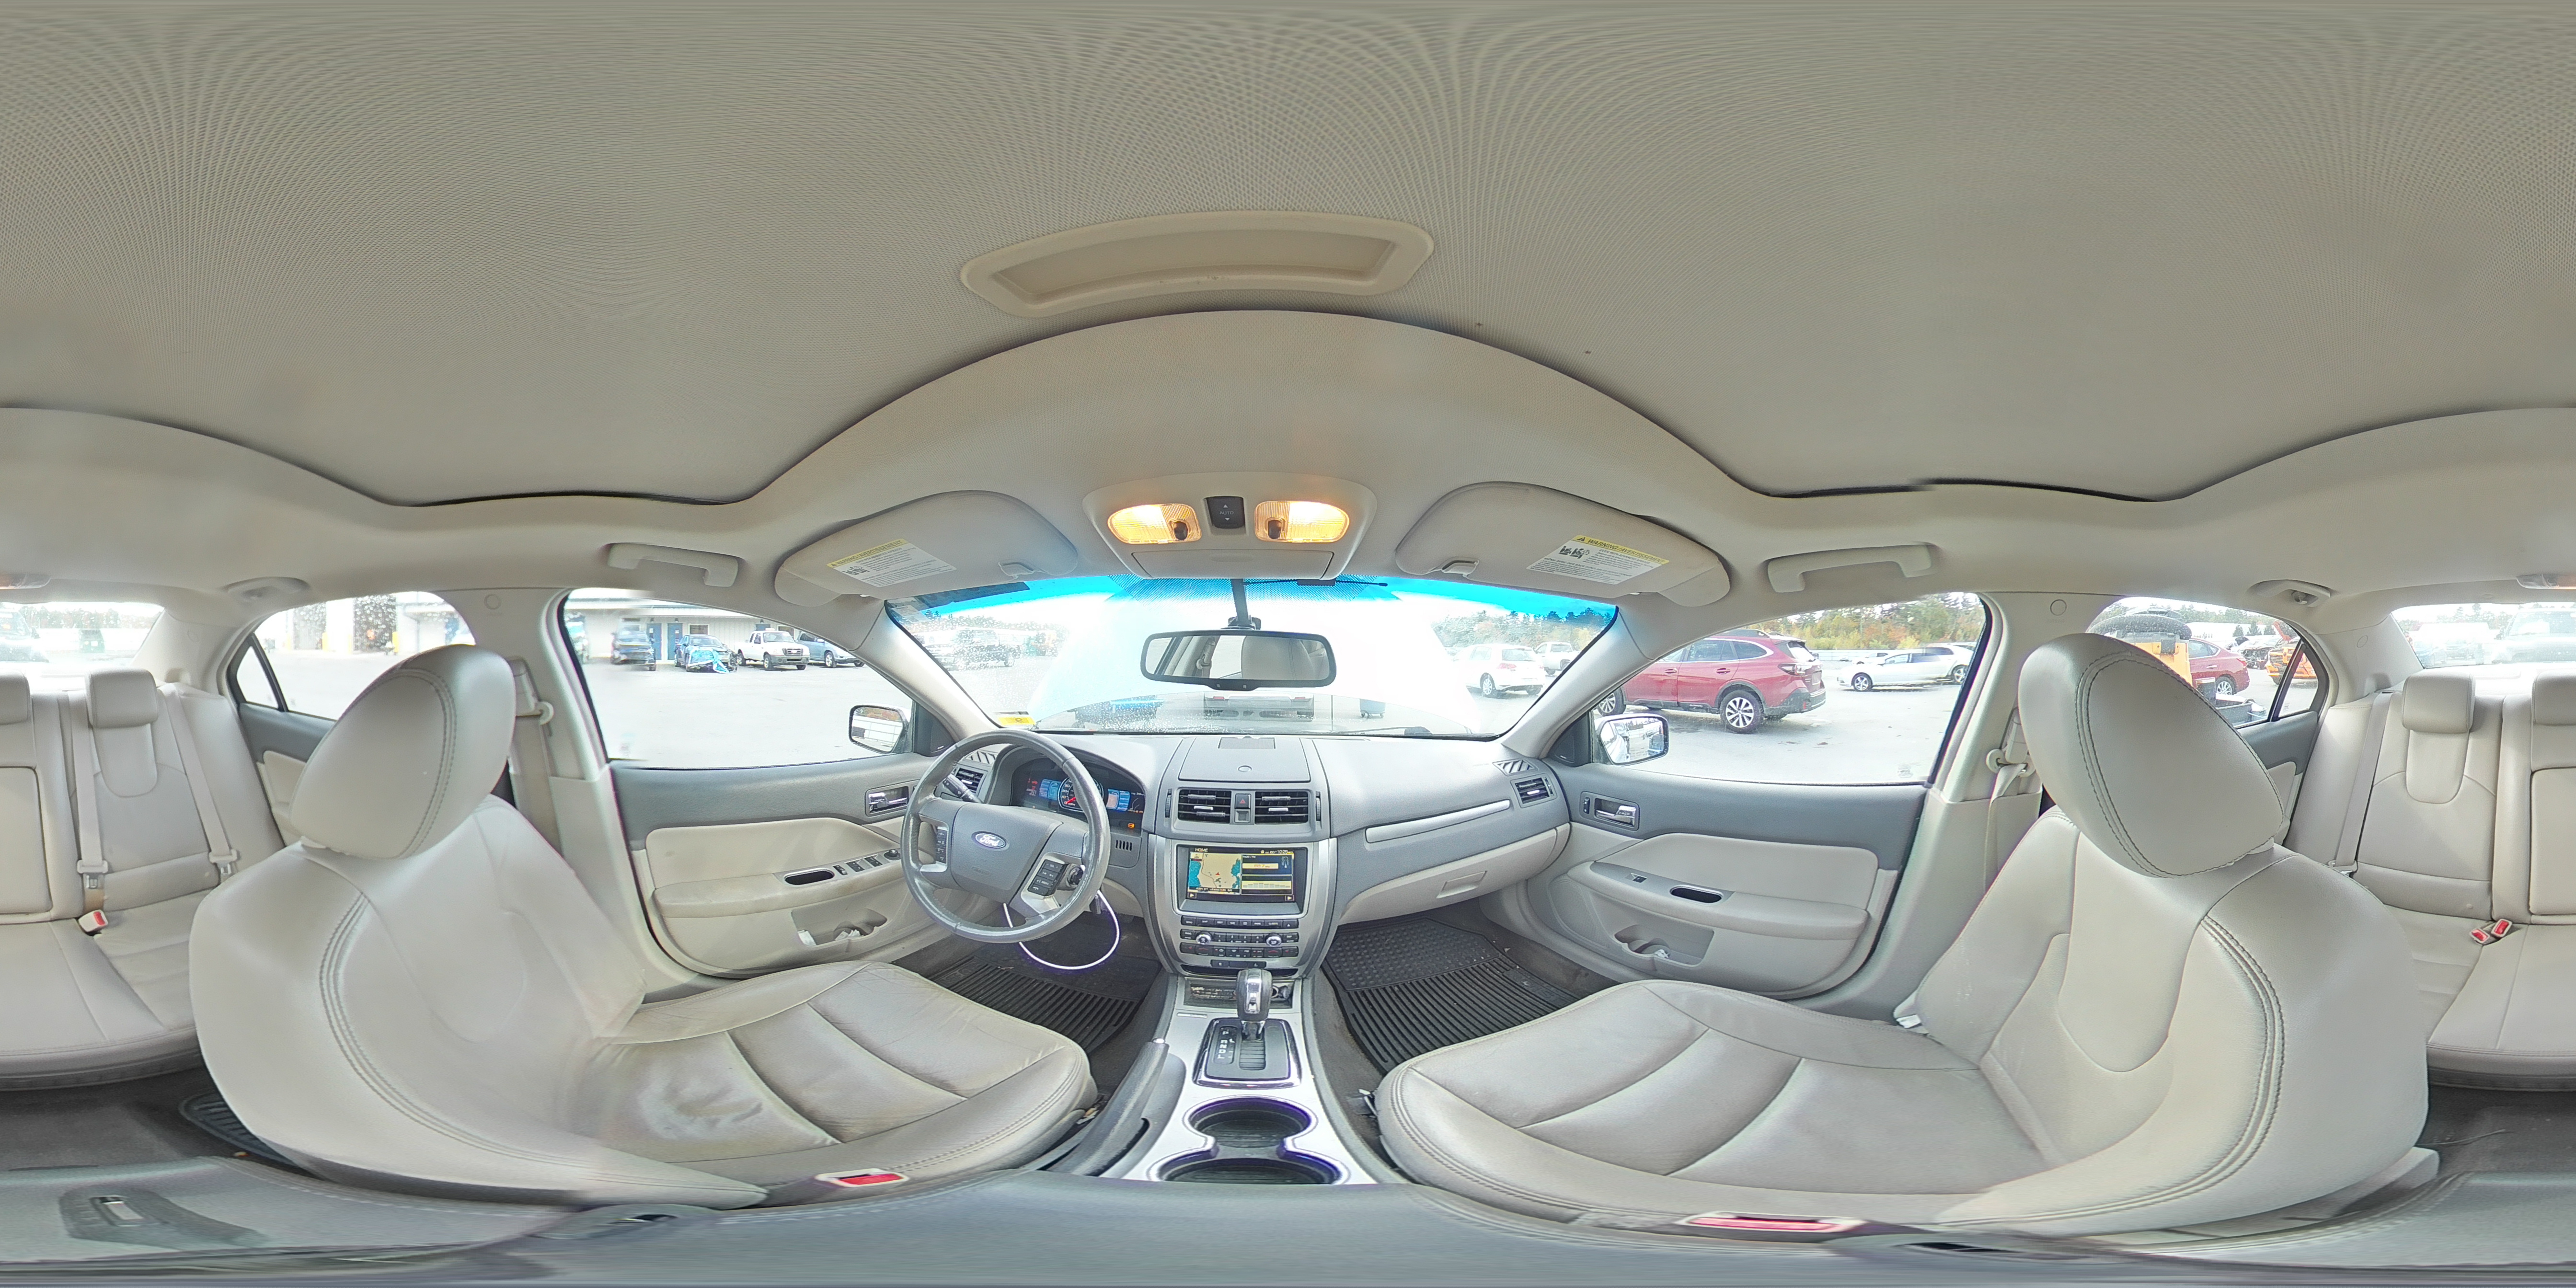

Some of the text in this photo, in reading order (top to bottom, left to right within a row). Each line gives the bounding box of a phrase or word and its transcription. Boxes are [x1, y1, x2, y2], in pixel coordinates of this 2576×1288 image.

[1587, 539, 1619, 550] WARNING
[1621, 548, 1666, 563] AVERTISSEMENT
[837, 555, 858, 564] WARNING
[979, 834, 999, 847] Ford
